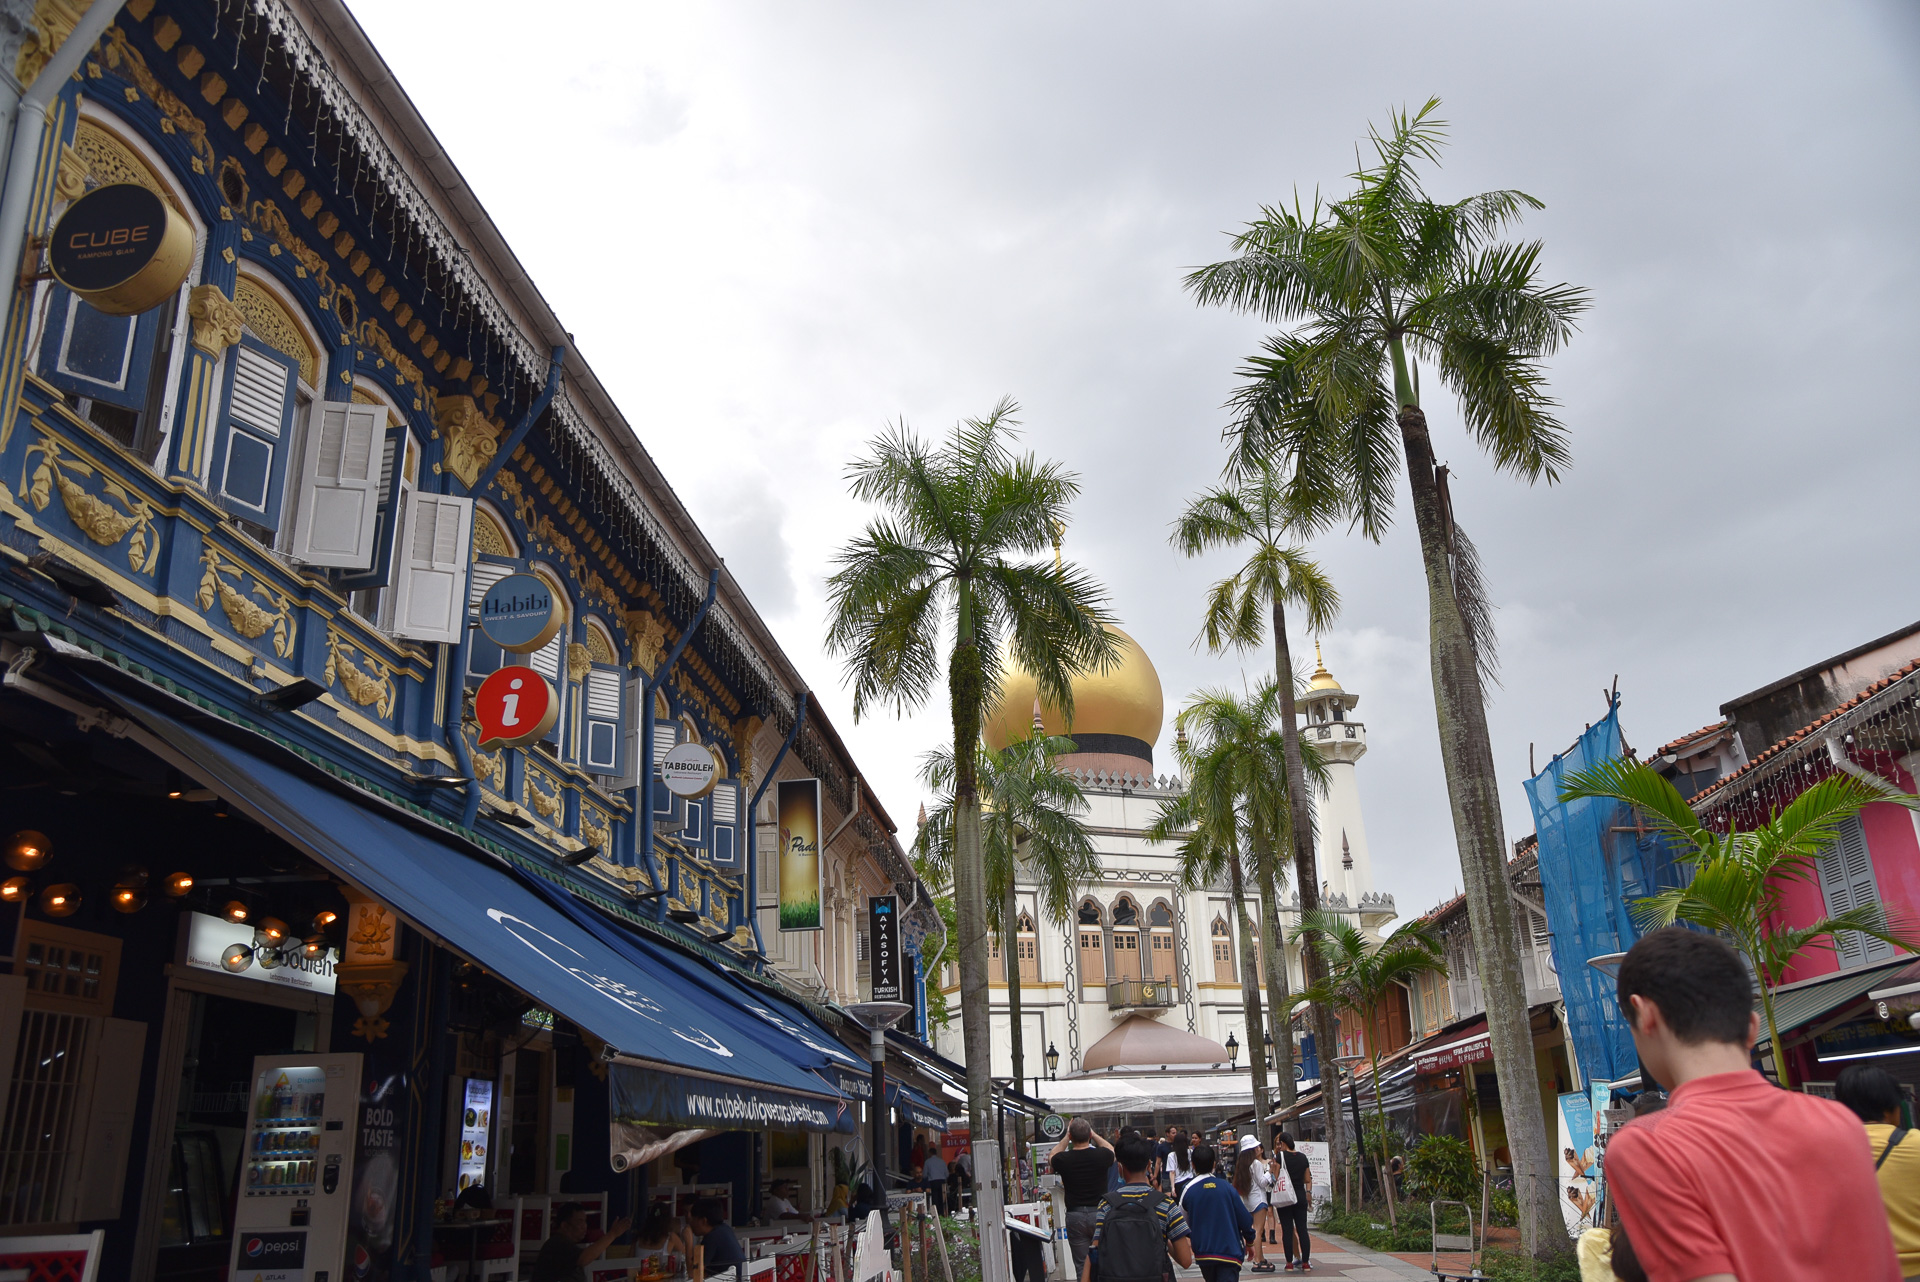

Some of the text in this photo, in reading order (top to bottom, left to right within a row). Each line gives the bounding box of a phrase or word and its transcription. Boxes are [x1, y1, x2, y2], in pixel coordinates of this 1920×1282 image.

[70, 226, 149, 248] CUBE
[485, 594, 548, 614] Habibi
[516, 610, 548, 618] SAVOURY
[664, 762, 713, 771] TABBOULEH
[880, 915, 889, 984] AYASOFYA
[366, 1108, 393, 1126] BOLD
[363, 1129, 394, 1147] TASTE
[264, 1239, 299, 1254] pepsi
